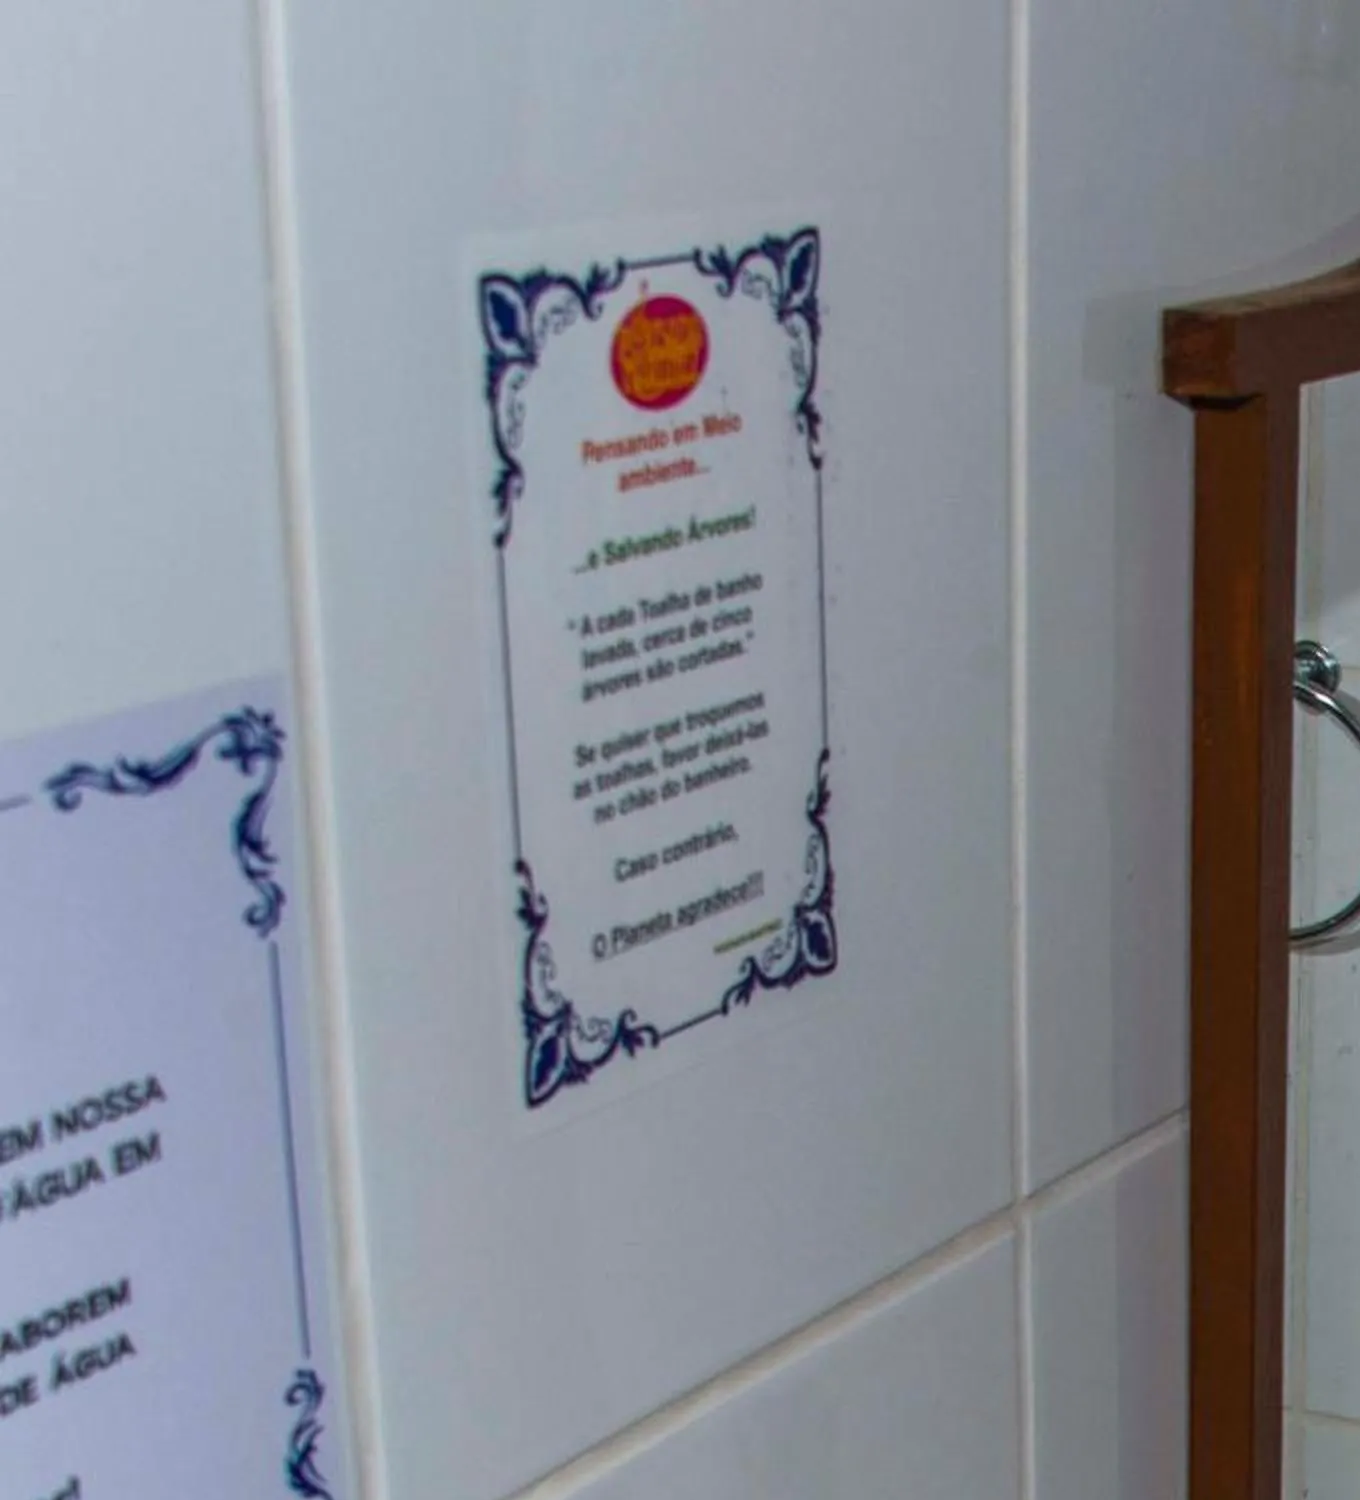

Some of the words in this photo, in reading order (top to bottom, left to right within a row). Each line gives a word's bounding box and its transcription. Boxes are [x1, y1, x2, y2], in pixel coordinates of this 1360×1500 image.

[581, 430, 669, 465] Pensando
[673, 422, 698, 447] em
[702, 413, 742, 436] Meio
[603, 525, 684, 566] Salvando
[597, 606, 636, 634] cada
[639, 592, 691, 622] Toalha
[694, 586, 712, 607] de
[715, 572, 763, 601] banho
[643, 624, 687, 652] cerca
[689, 617, 708, 640] de
[712, 604, 753, 633] cinco
[646, 656, 676, 682] são
[575, 744, 597, 769] Se
[602, 727, 652, 762] quiser
[653, 718, 682, 747] que
[685, 692, 766, 732] troquemos
[573, 778, 593, 800] as
[661, 742, 701, 769] favor
[594, 802, 616, 825] no
[618, 786, 659, 817] chão
[660, 777, 681, 802] do
[614, 854, 659, 884] Caso
[592, 931, 608, 963] O
[611, 911, 674, 957] Planeta
[51, 1073, 168, 1143] NOSSA
[10, 1154, 106, 1222] ÁGUA
[111, 1128, 162, 1176] EM
[50, 1332, 137, 1393] ÁGUA
